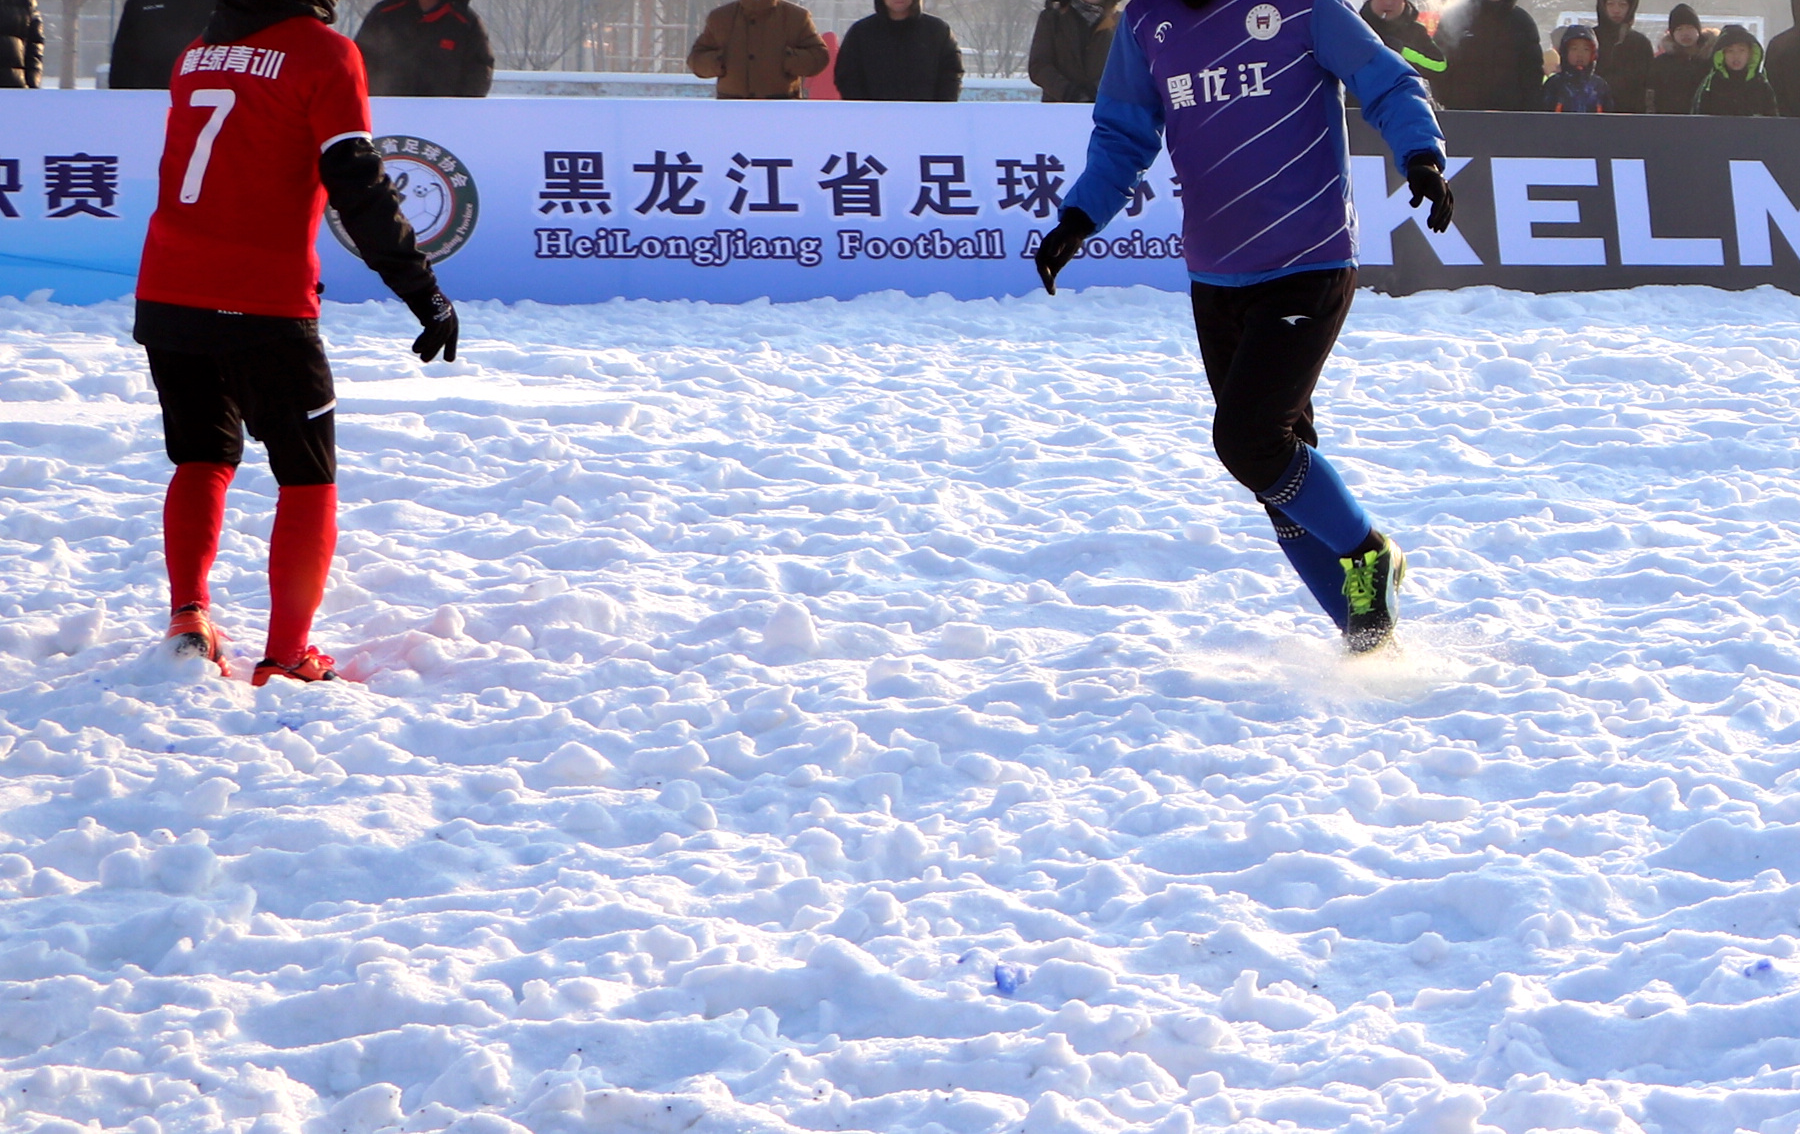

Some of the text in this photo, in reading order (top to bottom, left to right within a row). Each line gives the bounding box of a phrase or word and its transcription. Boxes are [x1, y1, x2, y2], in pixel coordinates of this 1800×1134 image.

[1167, 61, 1272, 110] 黑龙江
[179, 88, 237, 204] 7
[538, 150, 1184, 218] 黑龙江省足球
[535, 228, 1185, 266] HeiLongJiang Football Aociat
